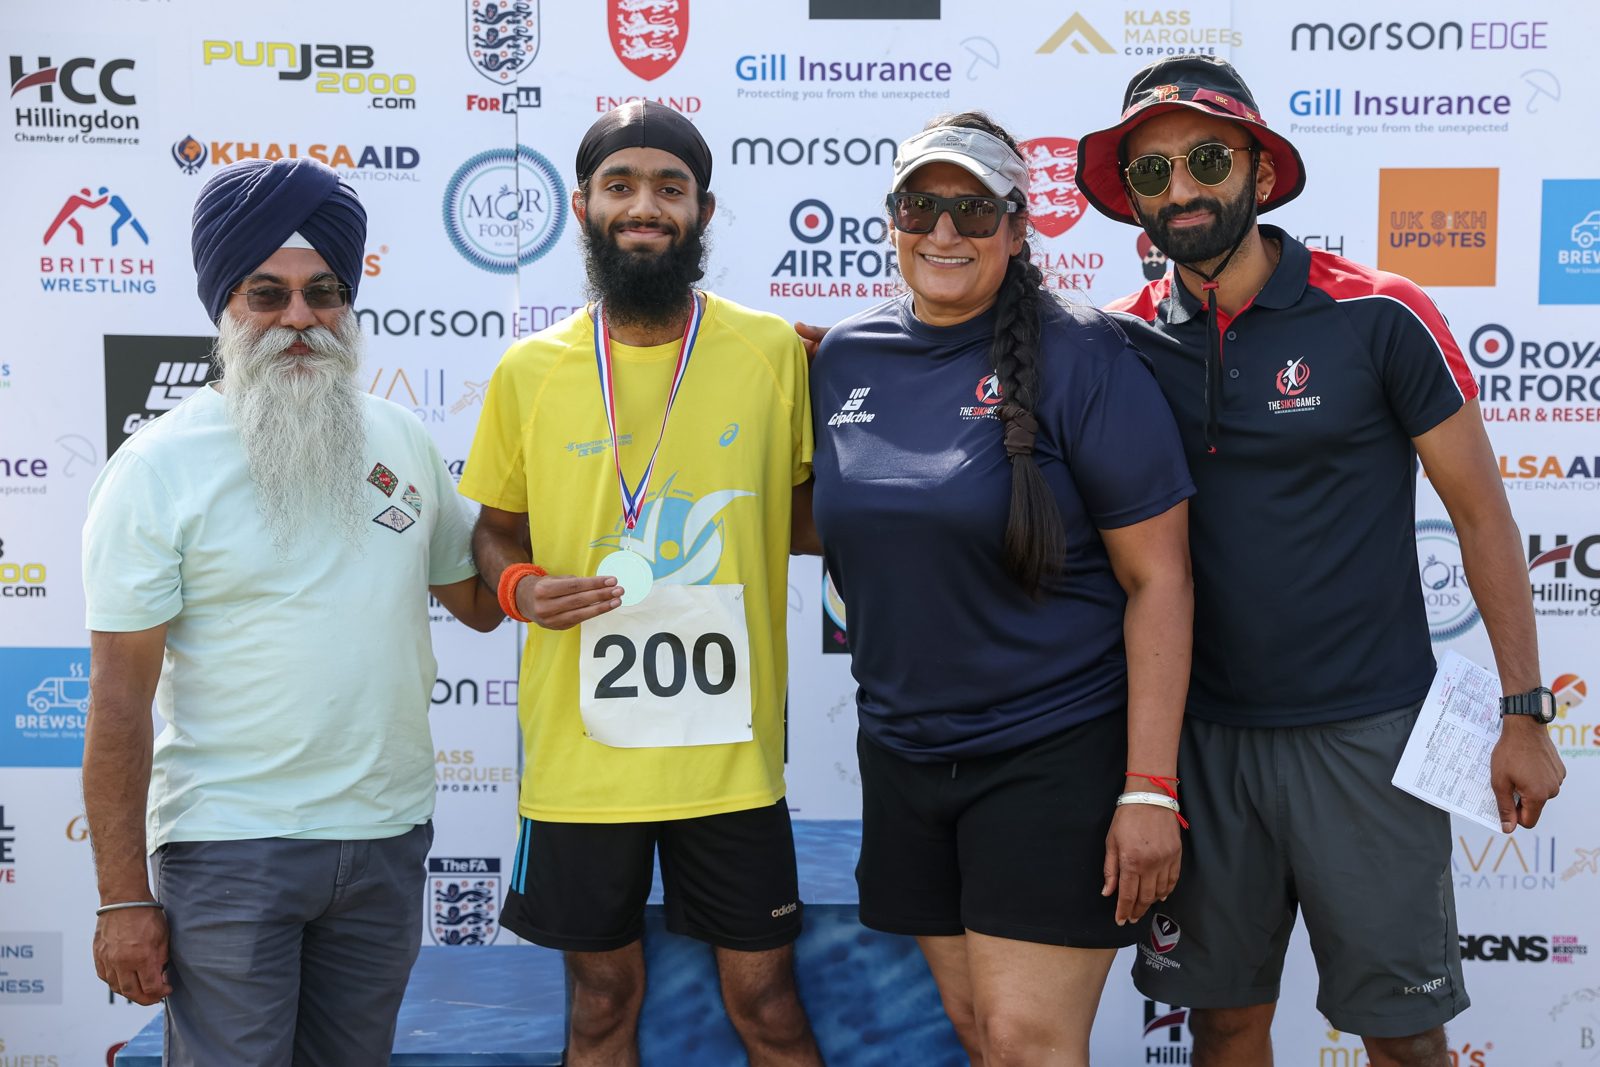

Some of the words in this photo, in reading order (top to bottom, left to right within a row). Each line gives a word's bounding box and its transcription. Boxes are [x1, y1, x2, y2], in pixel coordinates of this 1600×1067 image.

[1124, 10, 1191, 25] KLASS
[1124, 28, 1242, 47] MARQUEES
[1291, 21, 1463, 51] morson
[1471, 22, 1548, 49] EDGE
[1124, 47, 1215, 55] CORPORATE
[736, 54, 786, 81] Gill
[799, 56, 952, 81] Insurance
[10, 55, 137, 105] HCC
[315, 72, 416, 95] 2000
[737, 88, 799, 100] Protecting
[802, 91, 823, 100] you
[826, 88, 855, 98] from
[858, 88, 878, 98] the
[882, 88, 950, 100] unexpected
[1289, 89, 1341, 116] Gill
[1354, 90, 1511, 116] Insurance
[367, 97, 416, 110] .com
[15, 108, 140, 133] Hillingdon
[1290, 123, 1353, 135] Protecting
[1356, 125, 1378, 136] you
[1381, 122, 1411, 133] from
[1414, 122, 1434, 133] the
[1438, 122, 1509, 135] unexpected
[14, 133, 65, 143] Chamber
[68, 135, 79, 143] of
[82, 134, 140, 145] Commerce
[731, 138, 897, 165] morson
[1390, 211, 1424, 229] UK
[41, 258, 154, 275] BRITISH
[771, 250, 833, 277] AIR
[41, 278, 156, 294] WRESTLING
[770, 283, 851, 297] REGULAR
[855, 283, 868, 297] &
[828, 411, 876, 428] GripActive
[1535, 408, 1547, 422] &
[593, 631, 737, 699] 200
[771, 902, 797, 918] adidas
